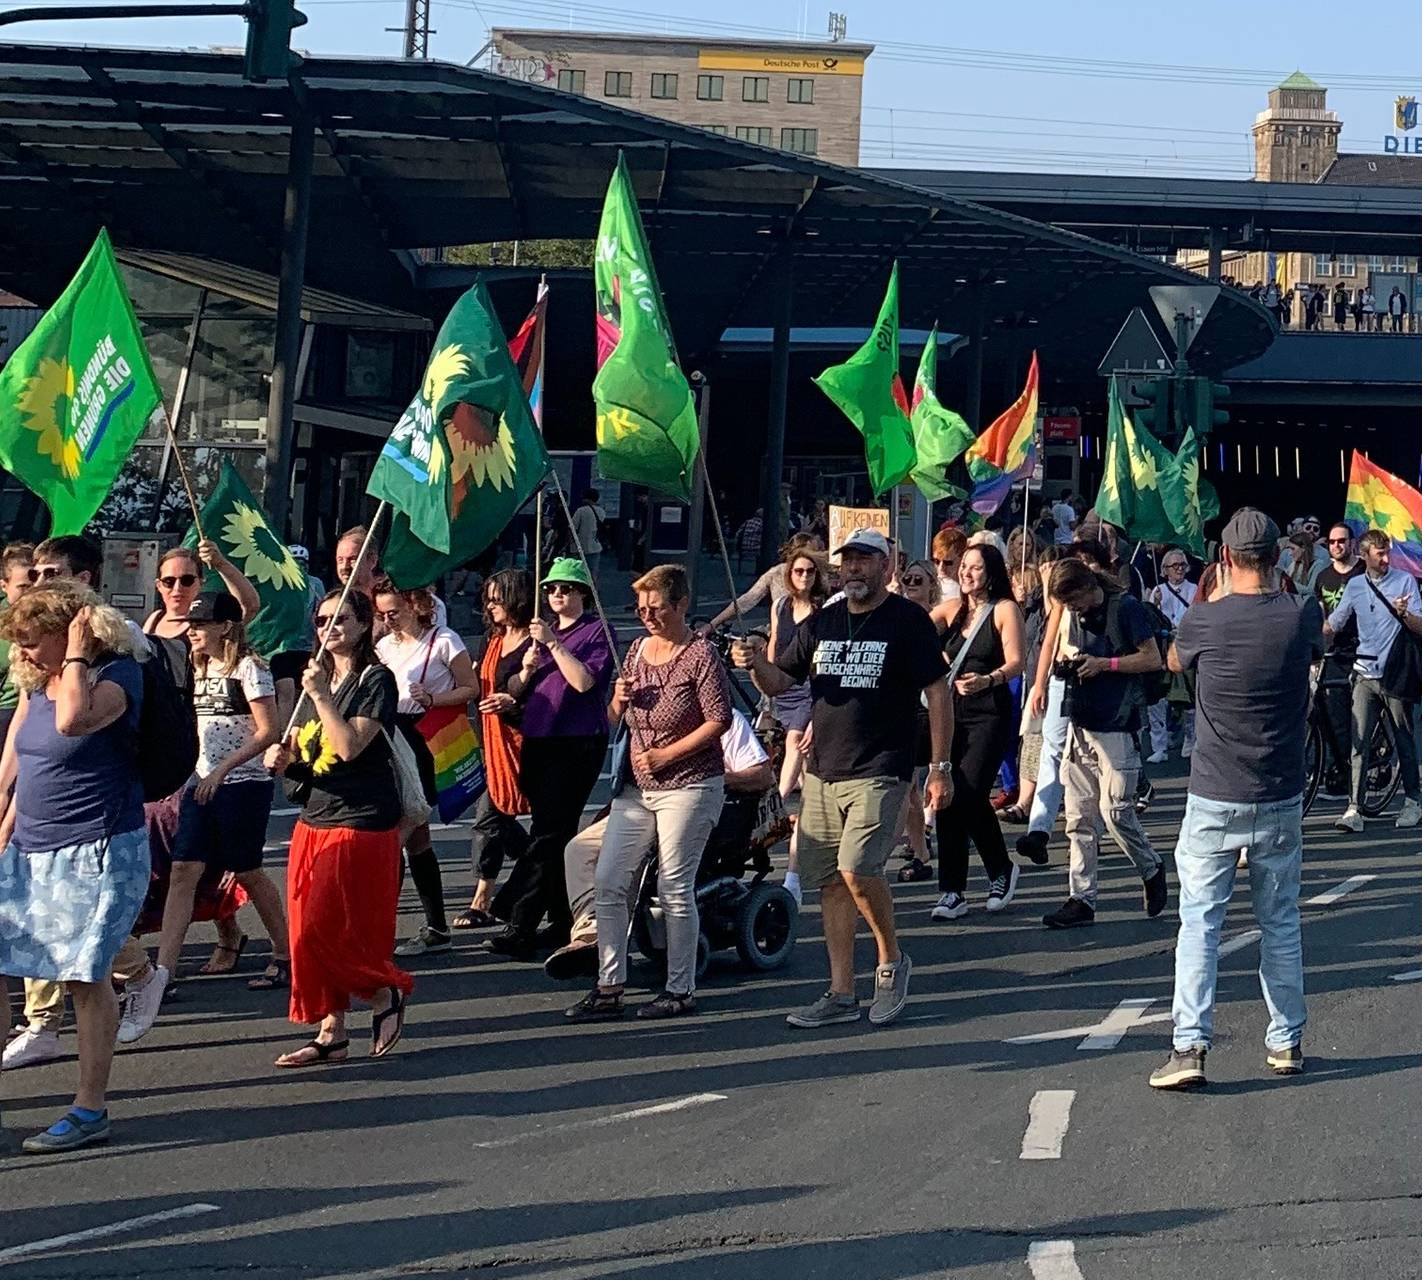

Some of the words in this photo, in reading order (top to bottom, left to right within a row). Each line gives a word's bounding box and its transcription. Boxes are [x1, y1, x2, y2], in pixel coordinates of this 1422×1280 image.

[763, 58, 801, 68] Deutsche
[802, 60, 820, 69] Post
[817, 640, 845, 652] MEINE
[846, 652, 861, 664] WO
[862, 652, 885, 665] EUER
[840, 676, 879, 689] BEGINNT.
